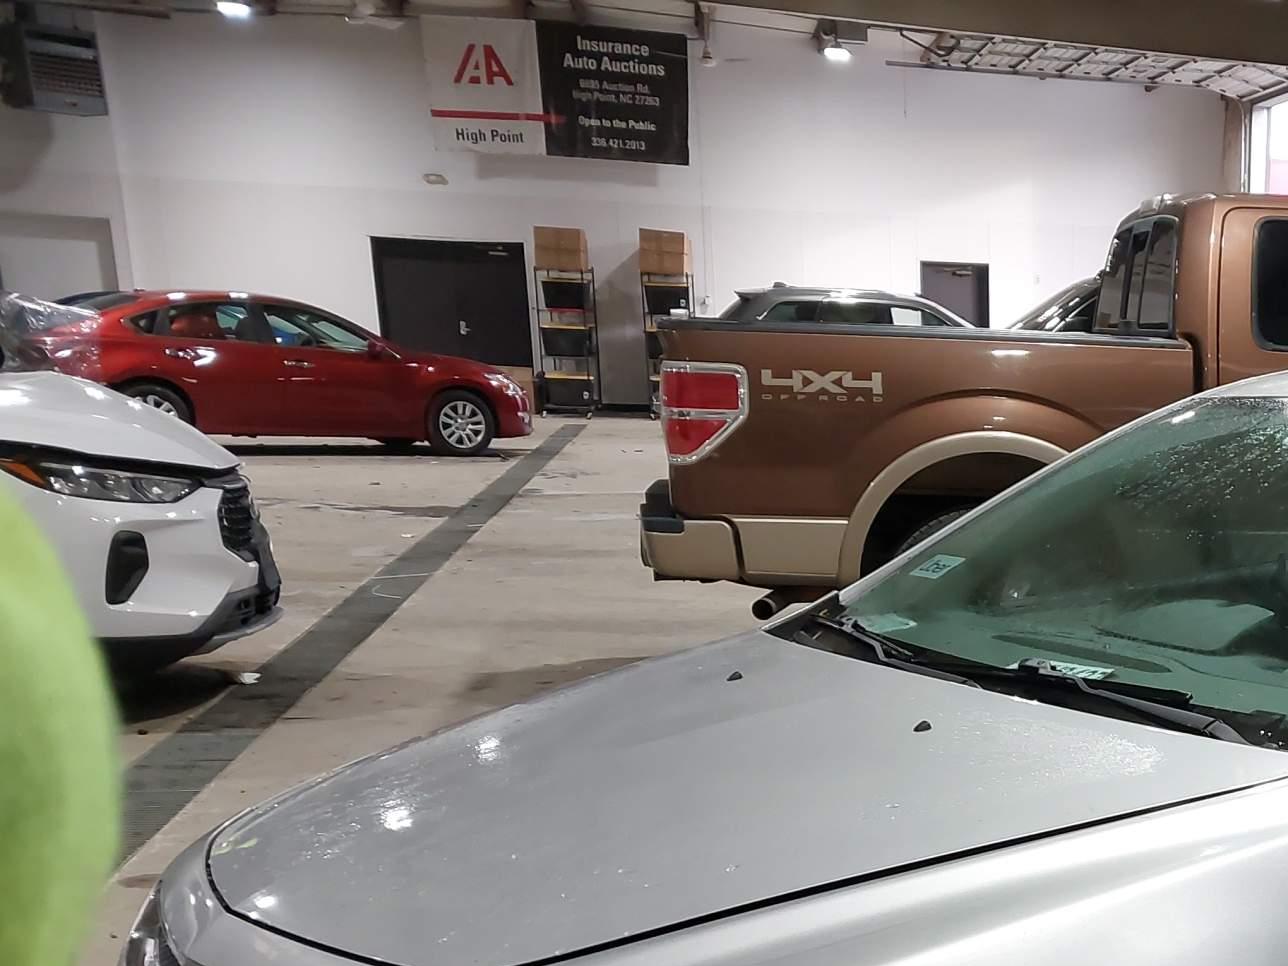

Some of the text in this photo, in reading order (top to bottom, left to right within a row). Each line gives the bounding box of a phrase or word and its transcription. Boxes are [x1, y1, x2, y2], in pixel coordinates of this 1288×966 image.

[576, 35, 650, 57] Insurance
[563, 53, 665, 77] Auto Auctions
[602, 80, 634, 92] Auction
[619, 93, 633, 104] NC
[578, 115, 657, 131] Open to the Public
[455, 128, 524, 145] High Point
[761, 369, 883, 394] 4X4
[818, 394, 883, 402] ROAD
